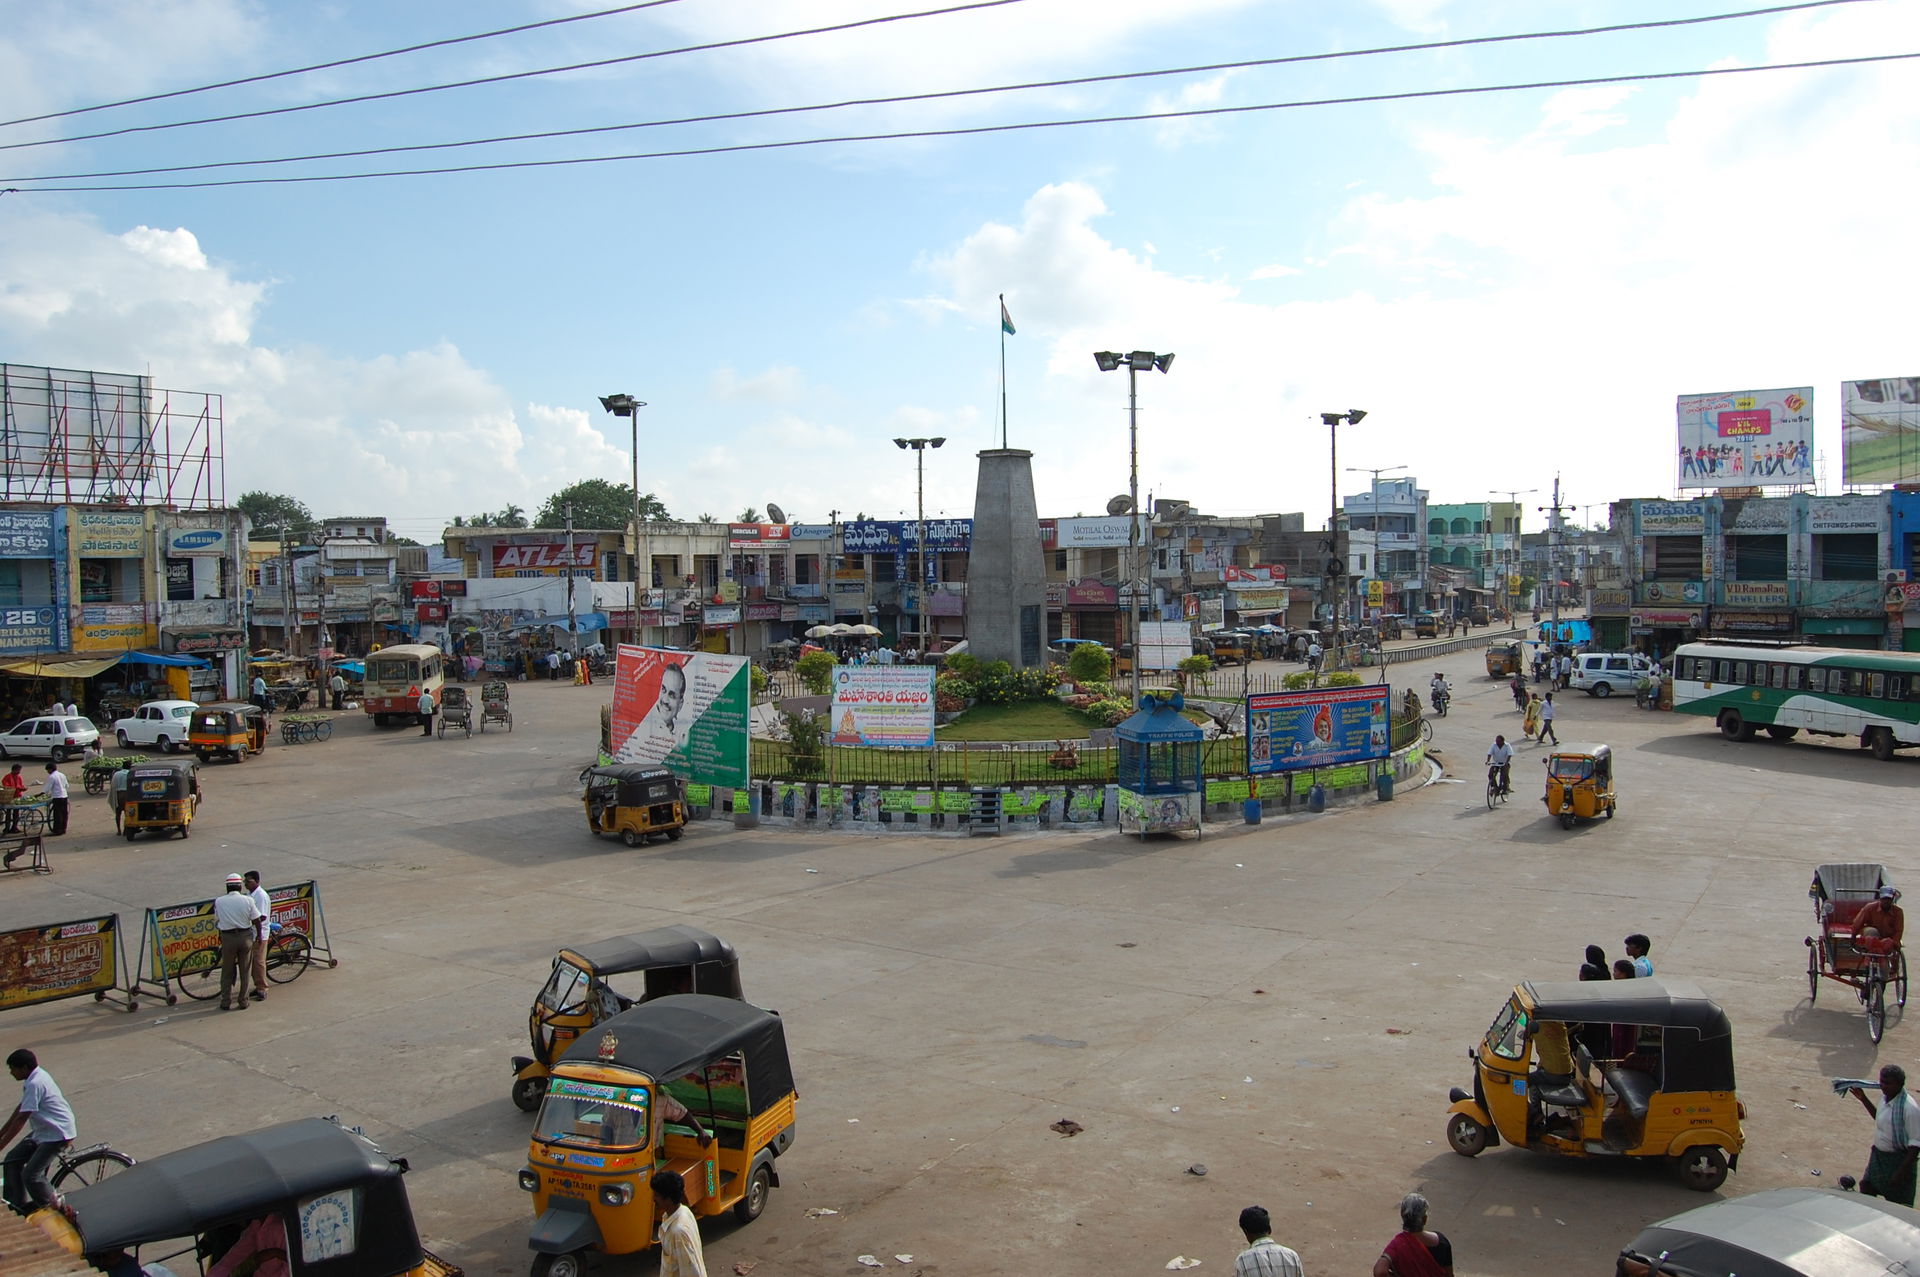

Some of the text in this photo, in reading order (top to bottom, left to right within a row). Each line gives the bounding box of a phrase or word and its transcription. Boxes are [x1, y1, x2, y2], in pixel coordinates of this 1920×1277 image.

[803, 528, 832, 536] Anagram
[1073, 525, 1128, 535] MOTILAL OSWAL
[499, 546, 595, 566] ATLAS
[927, 562, 935, 577] 1
[1728, 595, 1785, 603] JEWELLERS
[6, 611, 37, 625] 26
